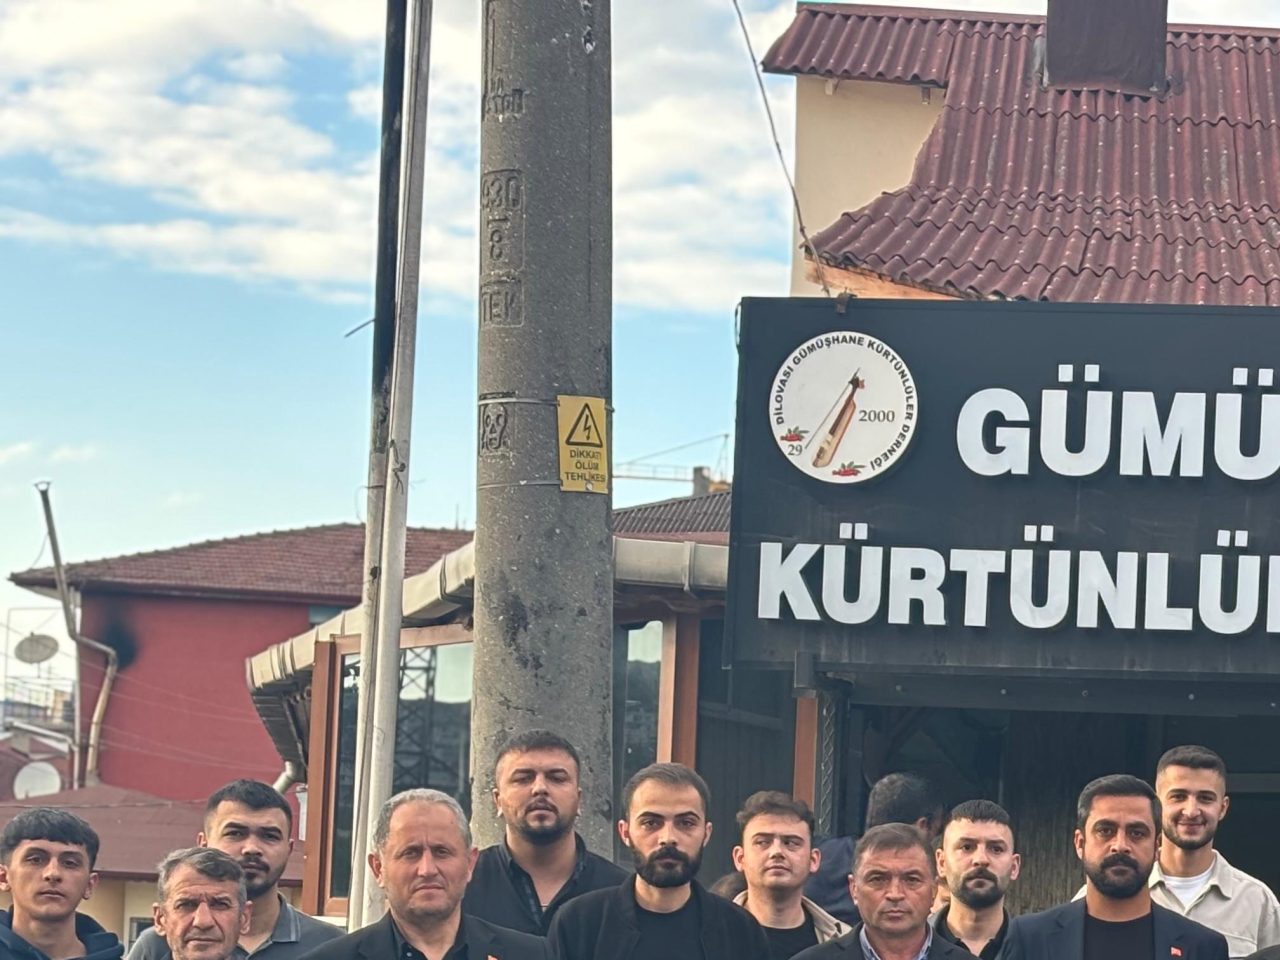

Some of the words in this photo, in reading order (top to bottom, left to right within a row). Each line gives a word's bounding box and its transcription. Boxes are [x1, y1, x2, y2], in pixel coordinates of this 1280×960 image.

[792, 335, 865, 365] GÜMÜŞHANE
[867, 339, 914, 421] KÜRTÜNLÜLER
[858, 410, 895, 422] 2000
[787, 444, 803, 456] 29
